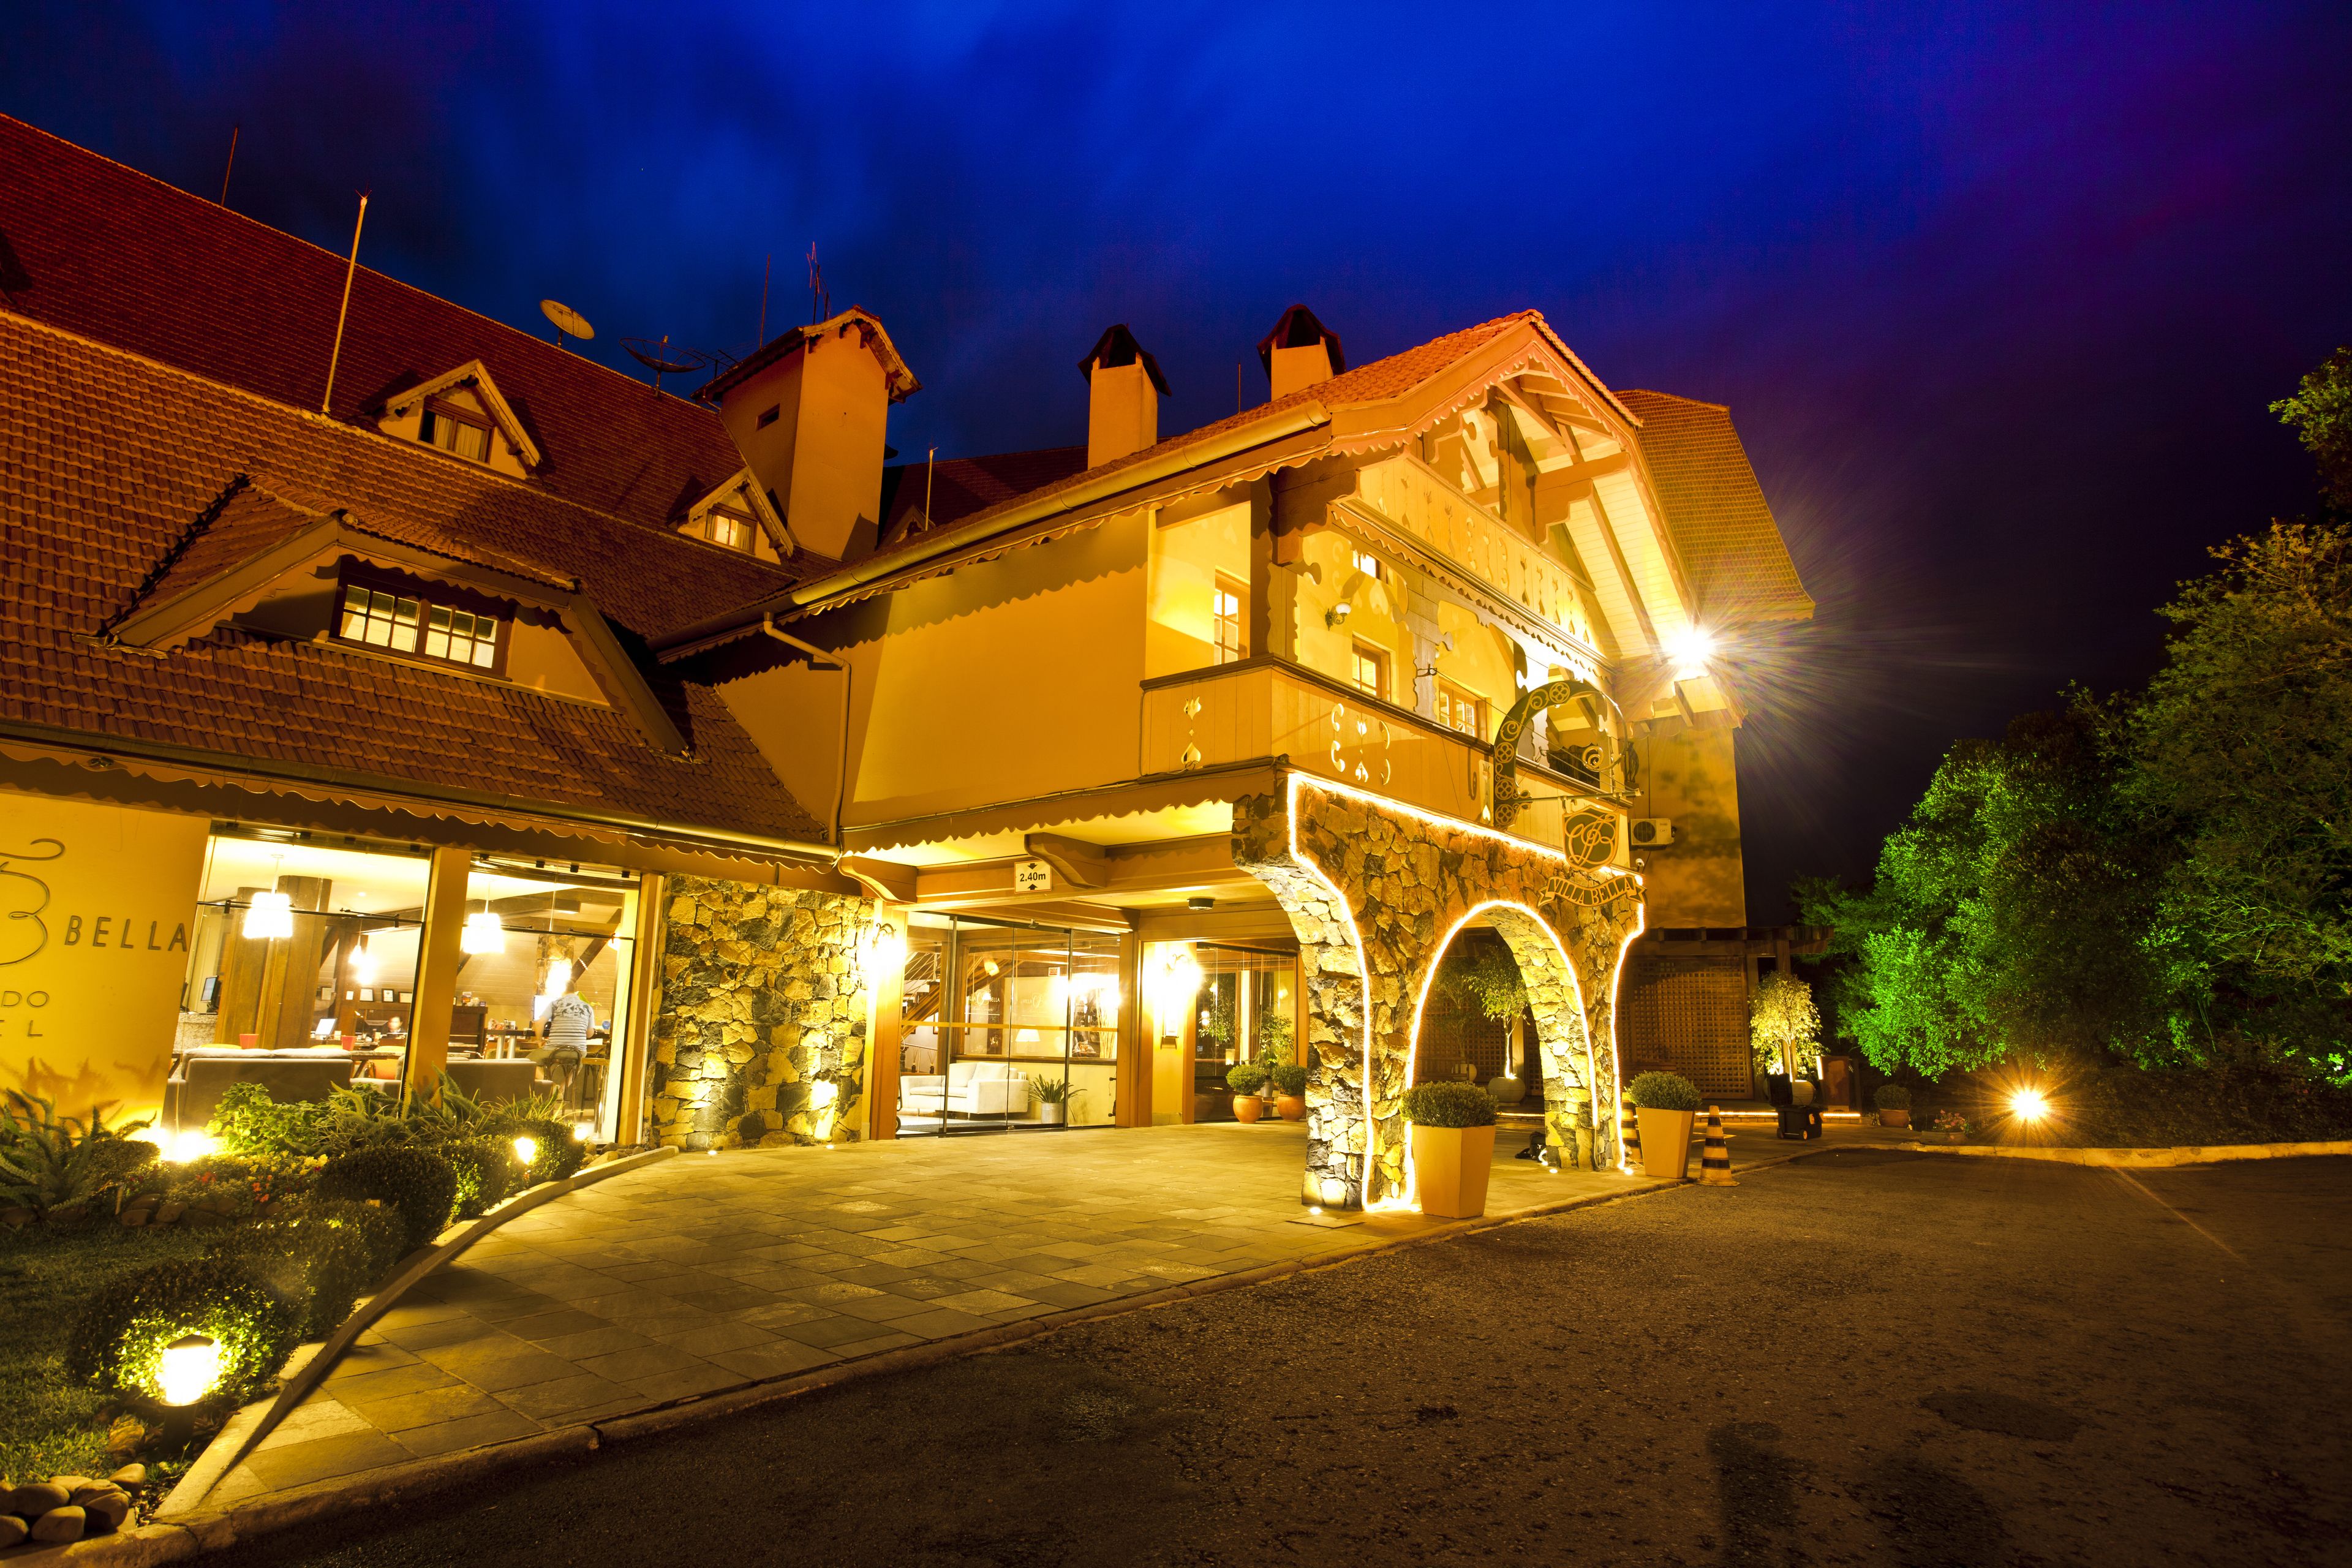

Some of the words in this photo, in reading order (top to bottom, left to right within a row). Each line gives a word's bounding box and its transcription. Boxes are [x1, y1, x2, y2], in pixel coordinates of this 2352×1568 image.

[1019, 872, 1046, 882] 2.40m
[1553, 878, 1585, 905] VILLA
[1591, 876, 1634, 905] BELLA
[64, 914, 187, 952] BELLA
